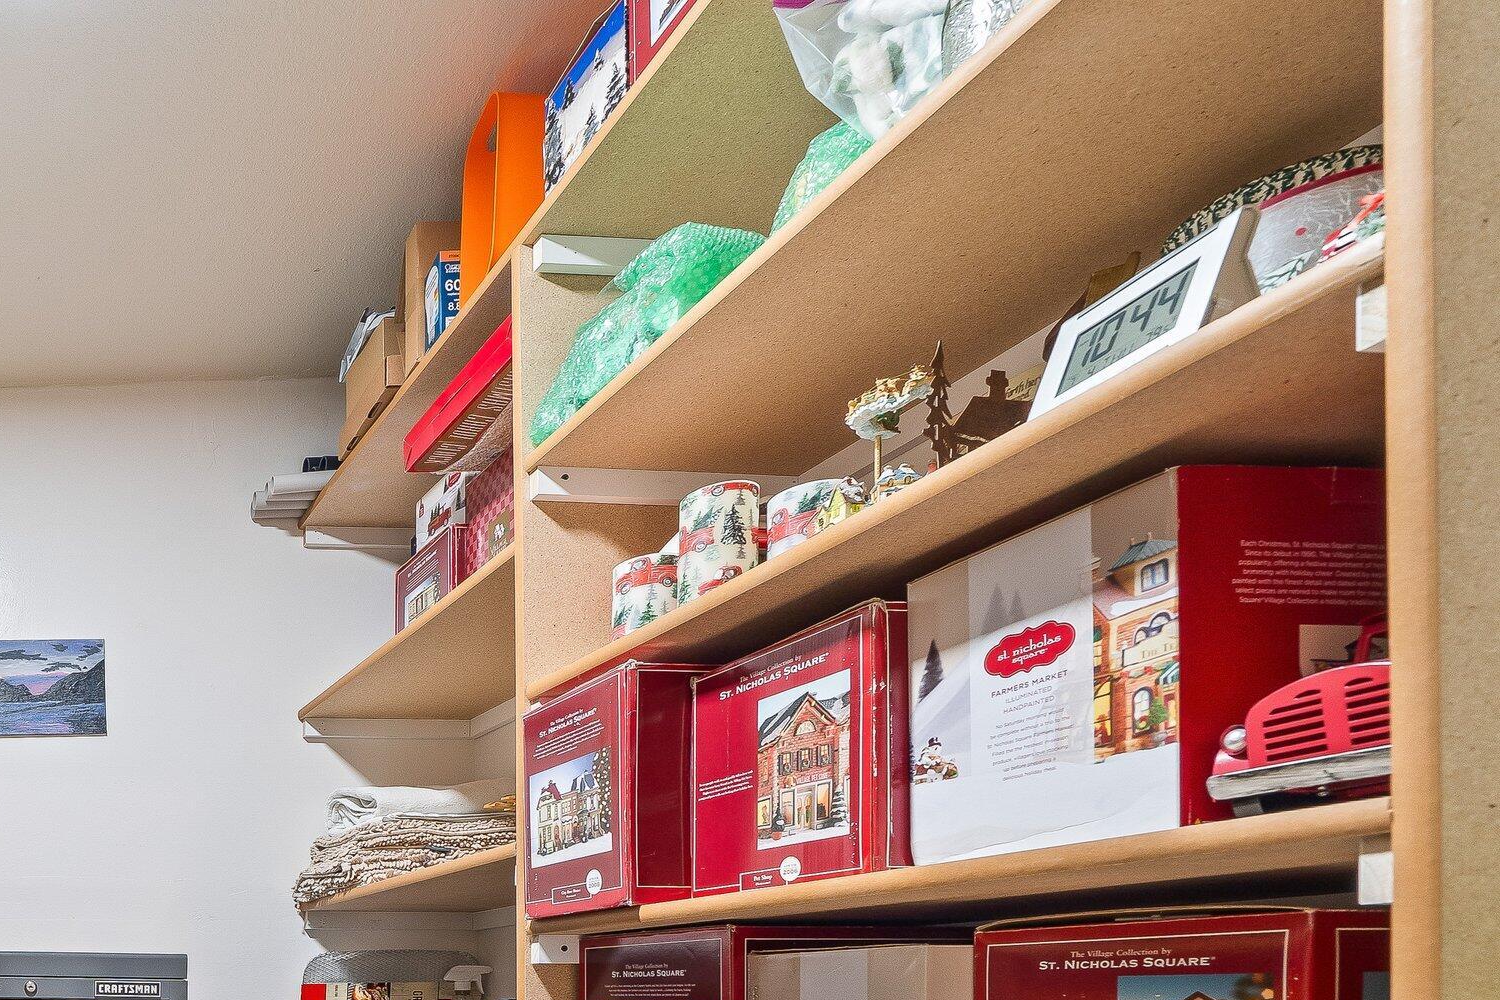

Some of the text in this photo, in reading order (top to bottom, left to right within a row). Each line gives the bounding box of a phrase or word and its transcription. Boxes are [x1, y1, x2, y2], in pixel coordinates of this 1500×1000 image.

[1012, 634, 1061, 657] nicholas
[1012, 648, 1046, 665] square
[719, 689, 734, 701] ST.
[736, 671, 782, 694] NICHOLAS
[991, 669, 1068, 698] FARMERS MARKET
[1005, 685, 1053, 704] ILLUMINATED
[1003, 695, 1055, 714] HANDPAINTED
[547, 720, 573, 735] NICHOLAS
[1087, 949, 1114, 959] Village
[1116, 948, 1158, 957] Collection
[1161, 948, 1172, 957] by
[1039, 961, 1060, 971] ST.
[1064, 959, 1139, 970] NICHOLAS
[611, 970, 622, 979] ST.
[622, 970, 655, 978] NICHOLAS
[98, 984, 158, 994] CRAFTSMAN
